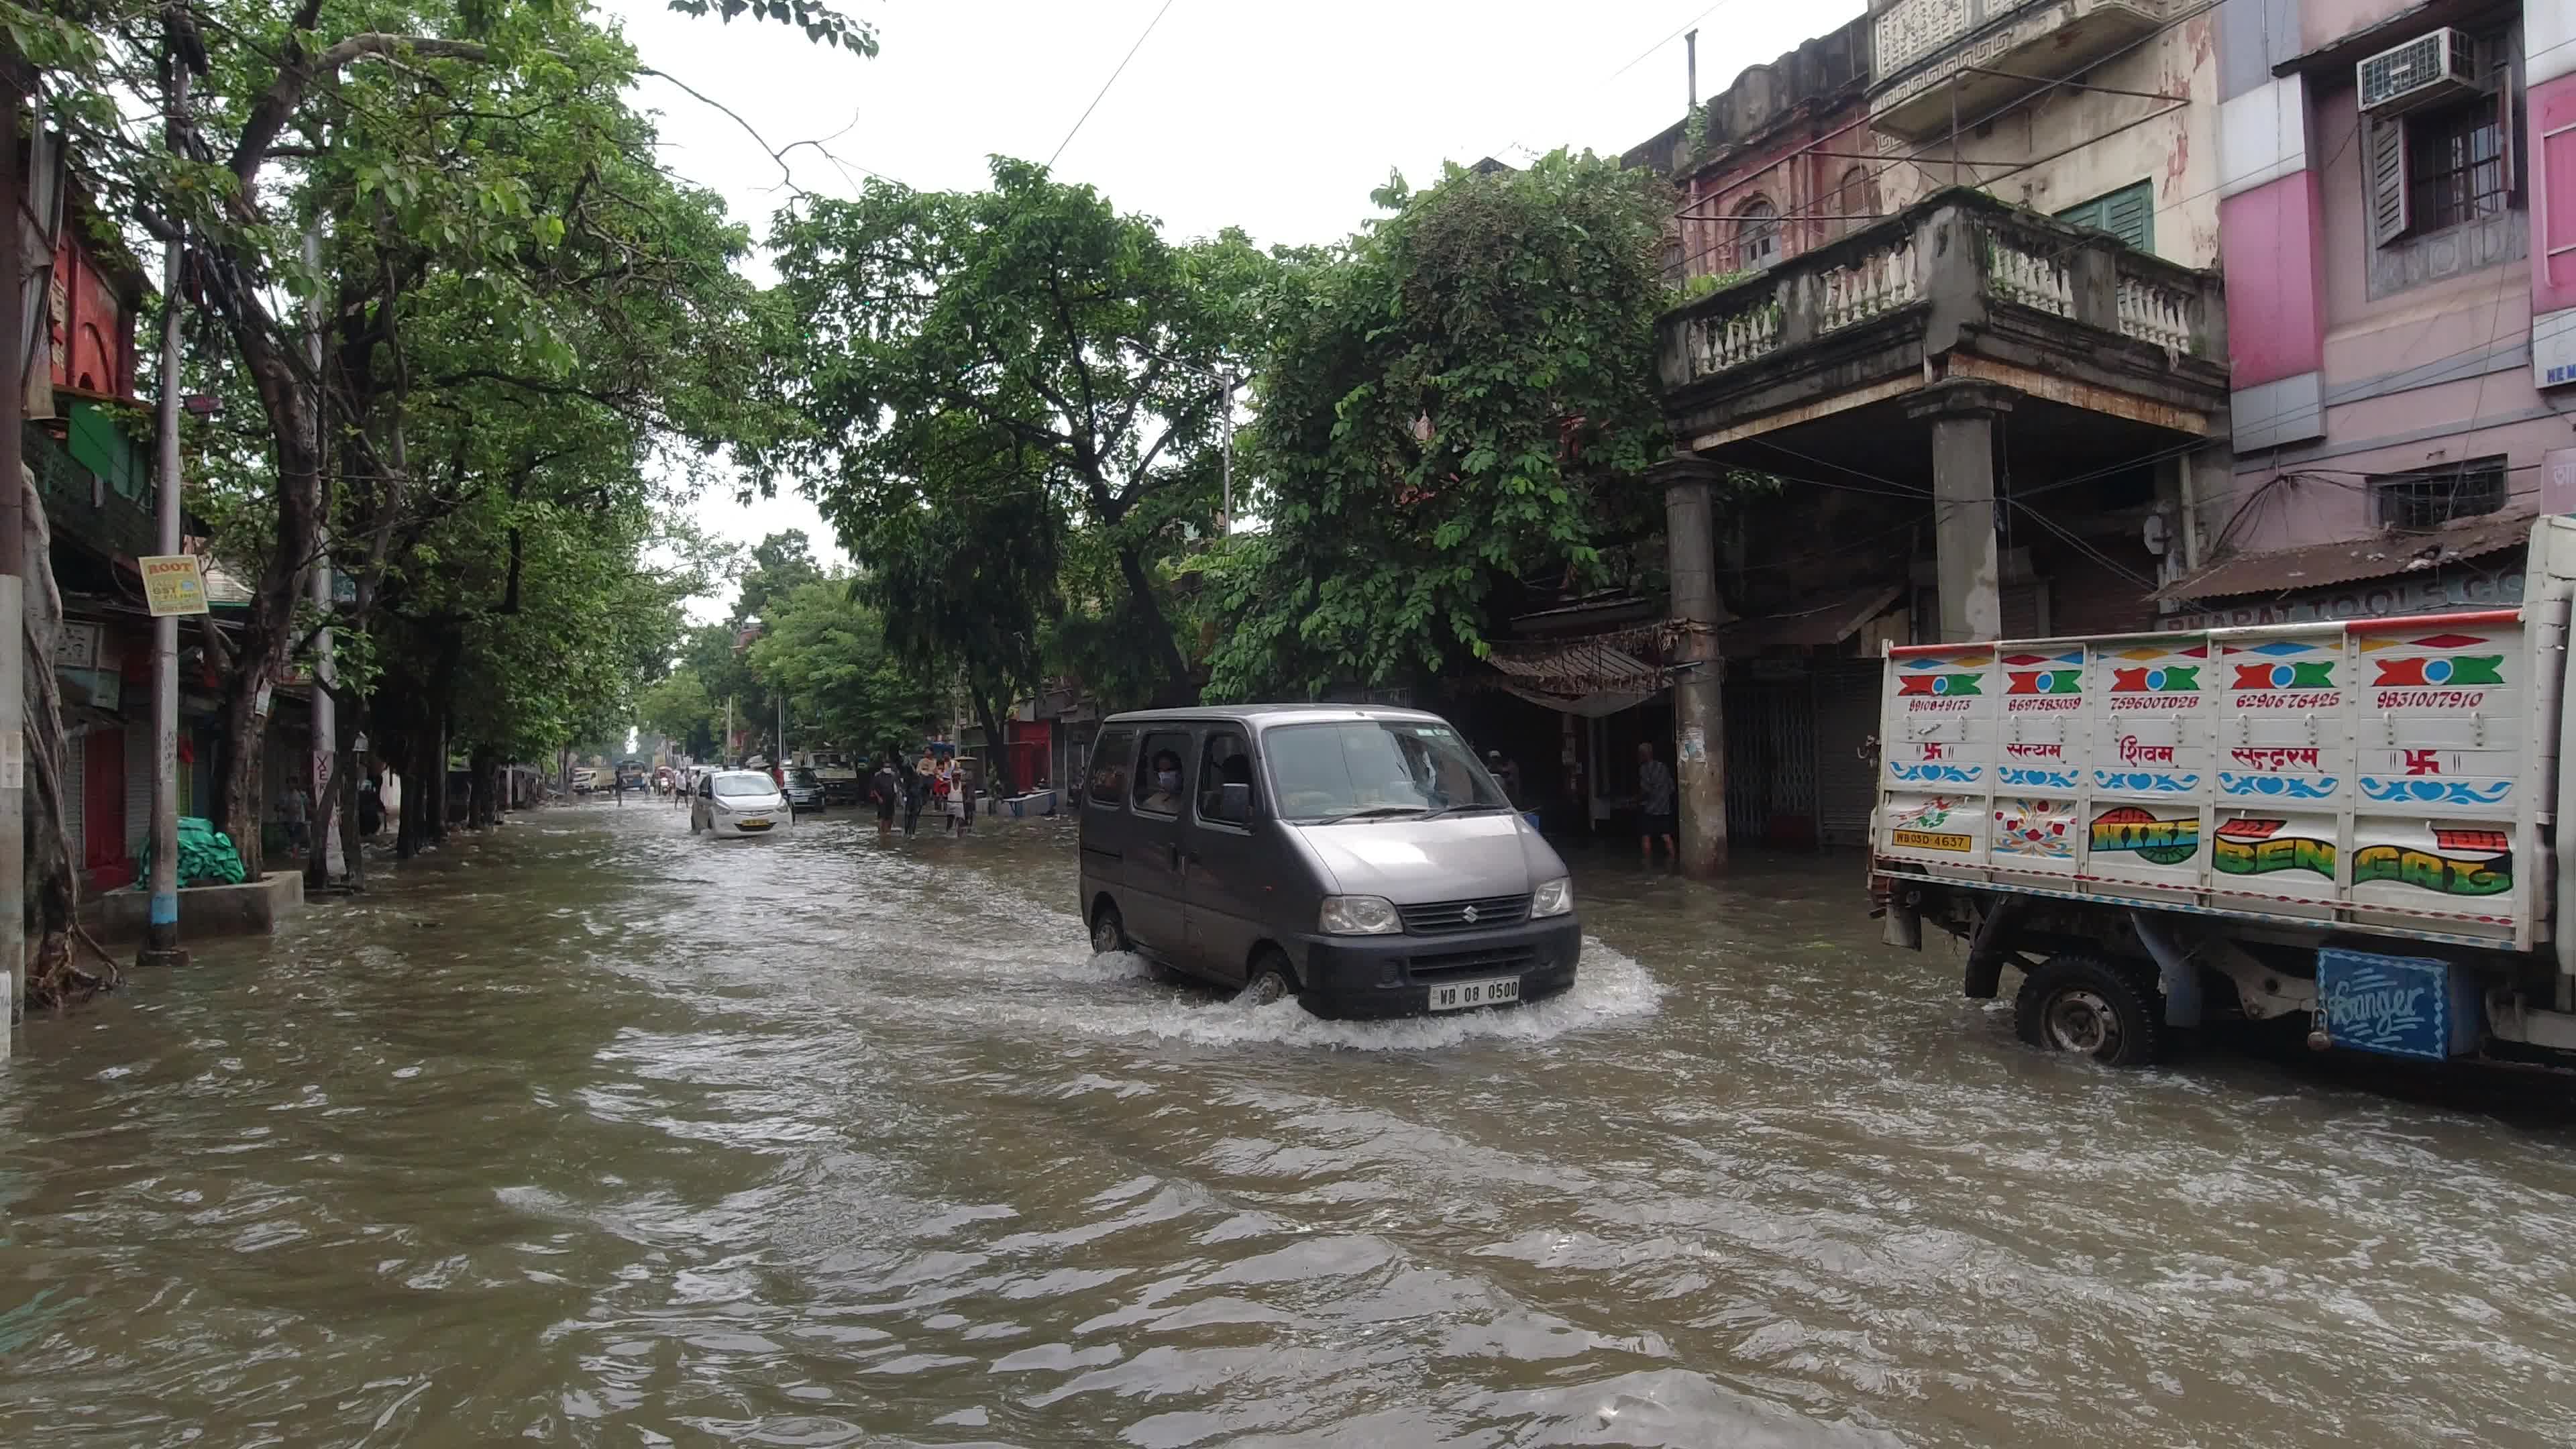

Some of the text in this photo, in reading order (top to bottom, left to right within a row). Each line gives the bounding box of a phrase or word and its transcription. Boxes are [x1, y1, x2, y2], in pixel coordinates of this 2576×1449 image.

[2377, 690, 2483, 708] 9831007910
[1934, 836, 1964, 847] 4637
[1464, 986, 1479, 1002] 08
[1488, 981, 1517, 999] 0500
